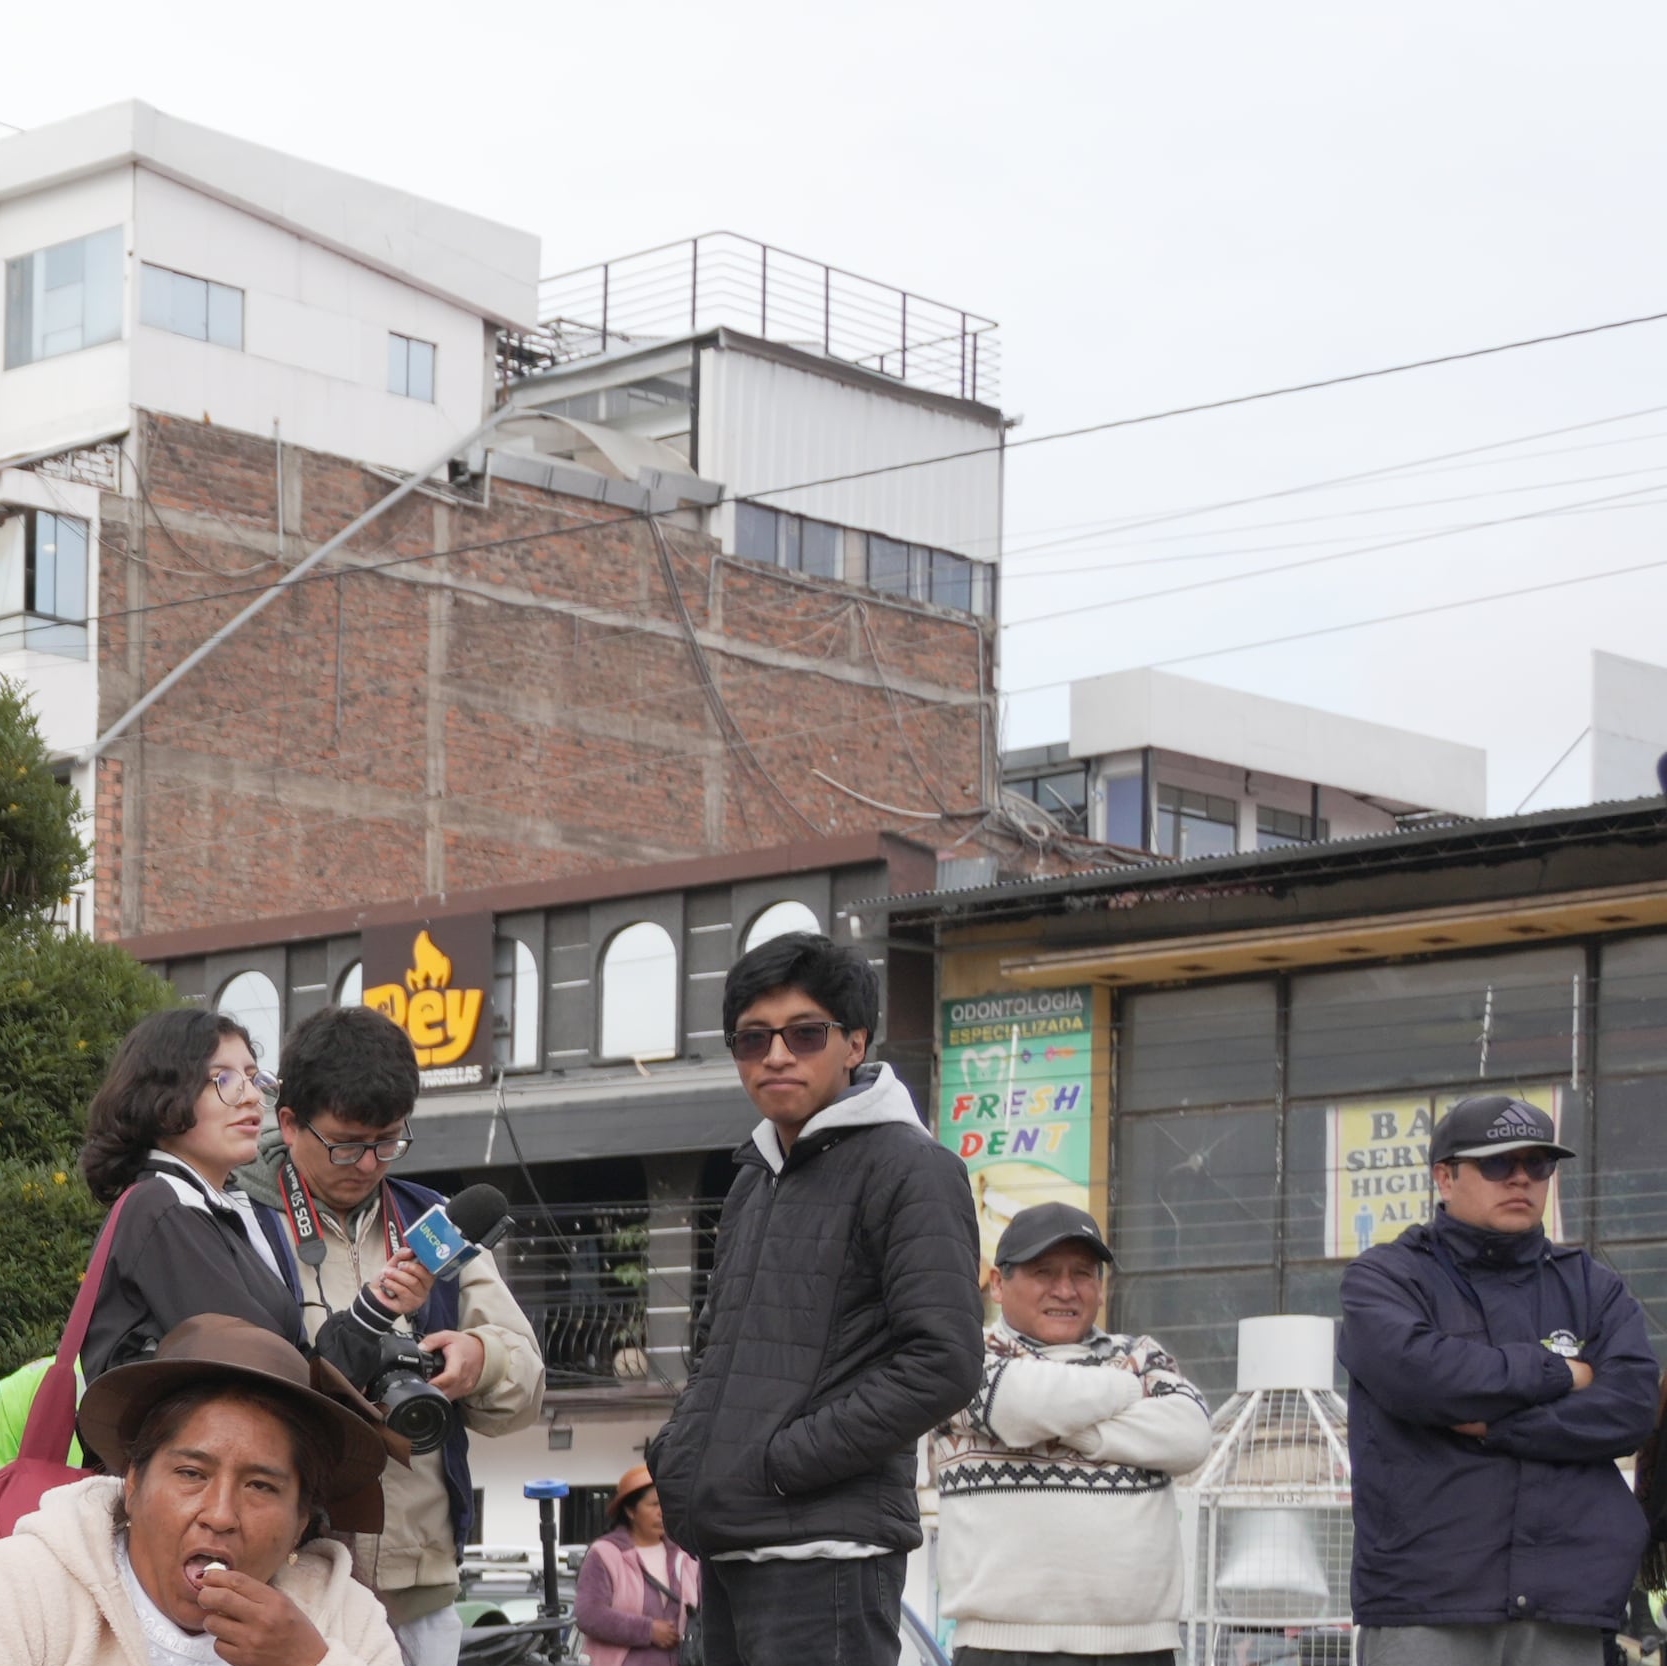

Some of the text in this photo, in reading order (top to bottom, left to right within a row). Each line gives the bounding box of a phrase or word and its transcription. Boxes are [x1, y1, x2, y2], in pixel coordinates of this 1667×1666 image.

[949, 1016, 1084, 1046] ESPECIALIZADA
[952, 1085, 1080, 1121] FRESH
[960, 1124, 1069, 1157] DENT
[1486, 1121, 1545, 1141] adidas
[294, 1207, 313, 1238] EOS
